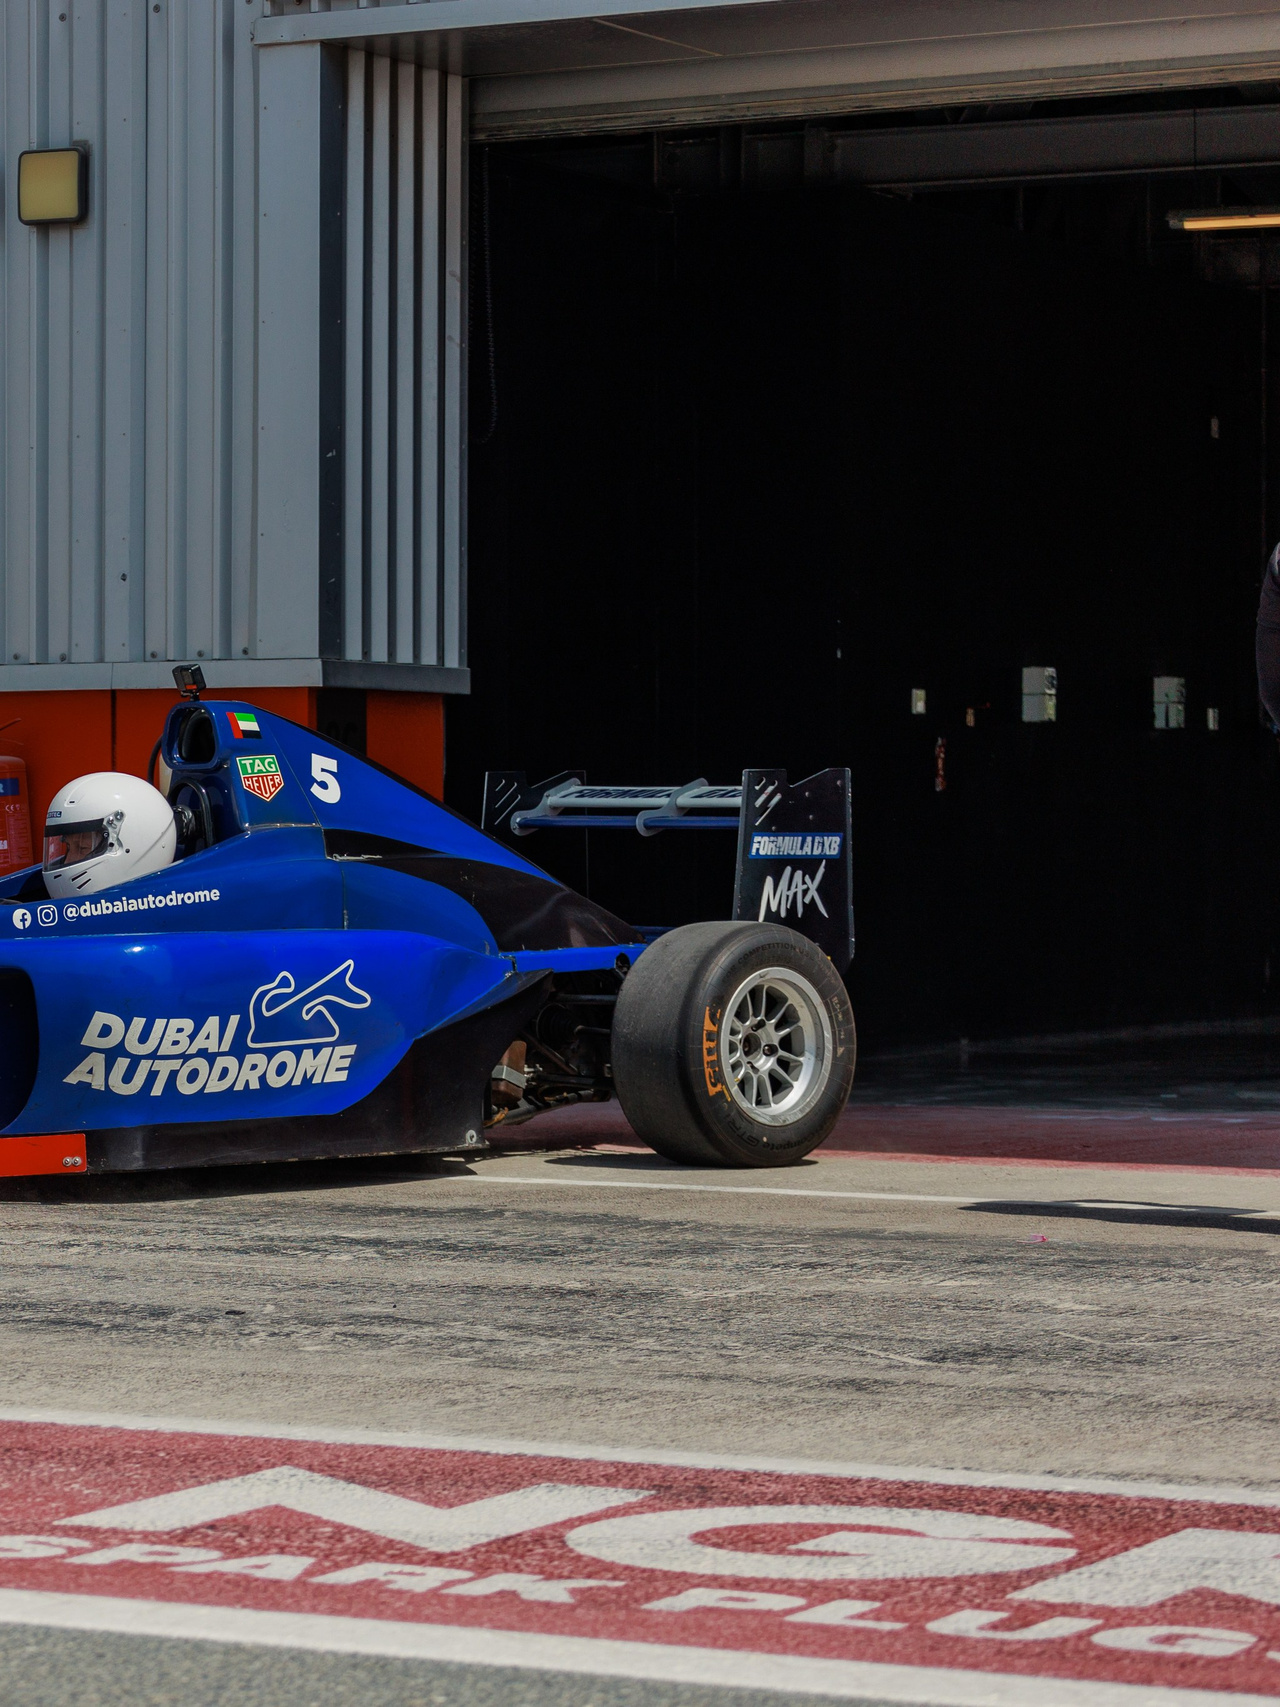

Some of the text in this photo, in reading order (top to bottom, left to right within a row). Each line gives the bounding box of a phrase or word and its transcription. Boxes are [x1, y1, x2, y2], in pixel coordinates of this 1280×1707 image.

[241, 758, 276, 774] TAG
[245, 775, 282, 799] HEUER
[310, 753, 341, 804] 5
[63, 889, 220, 922] @dubaiautodrome
[758, 859, 829, 922] MAX
[738, 943, 797, 964] COMPETITION
[80, 1010, 241, 1056] DUBAI
[62, 1044, 358, 1097] AUTODROME
[642, 1587, 1280, 1661] PLUG
